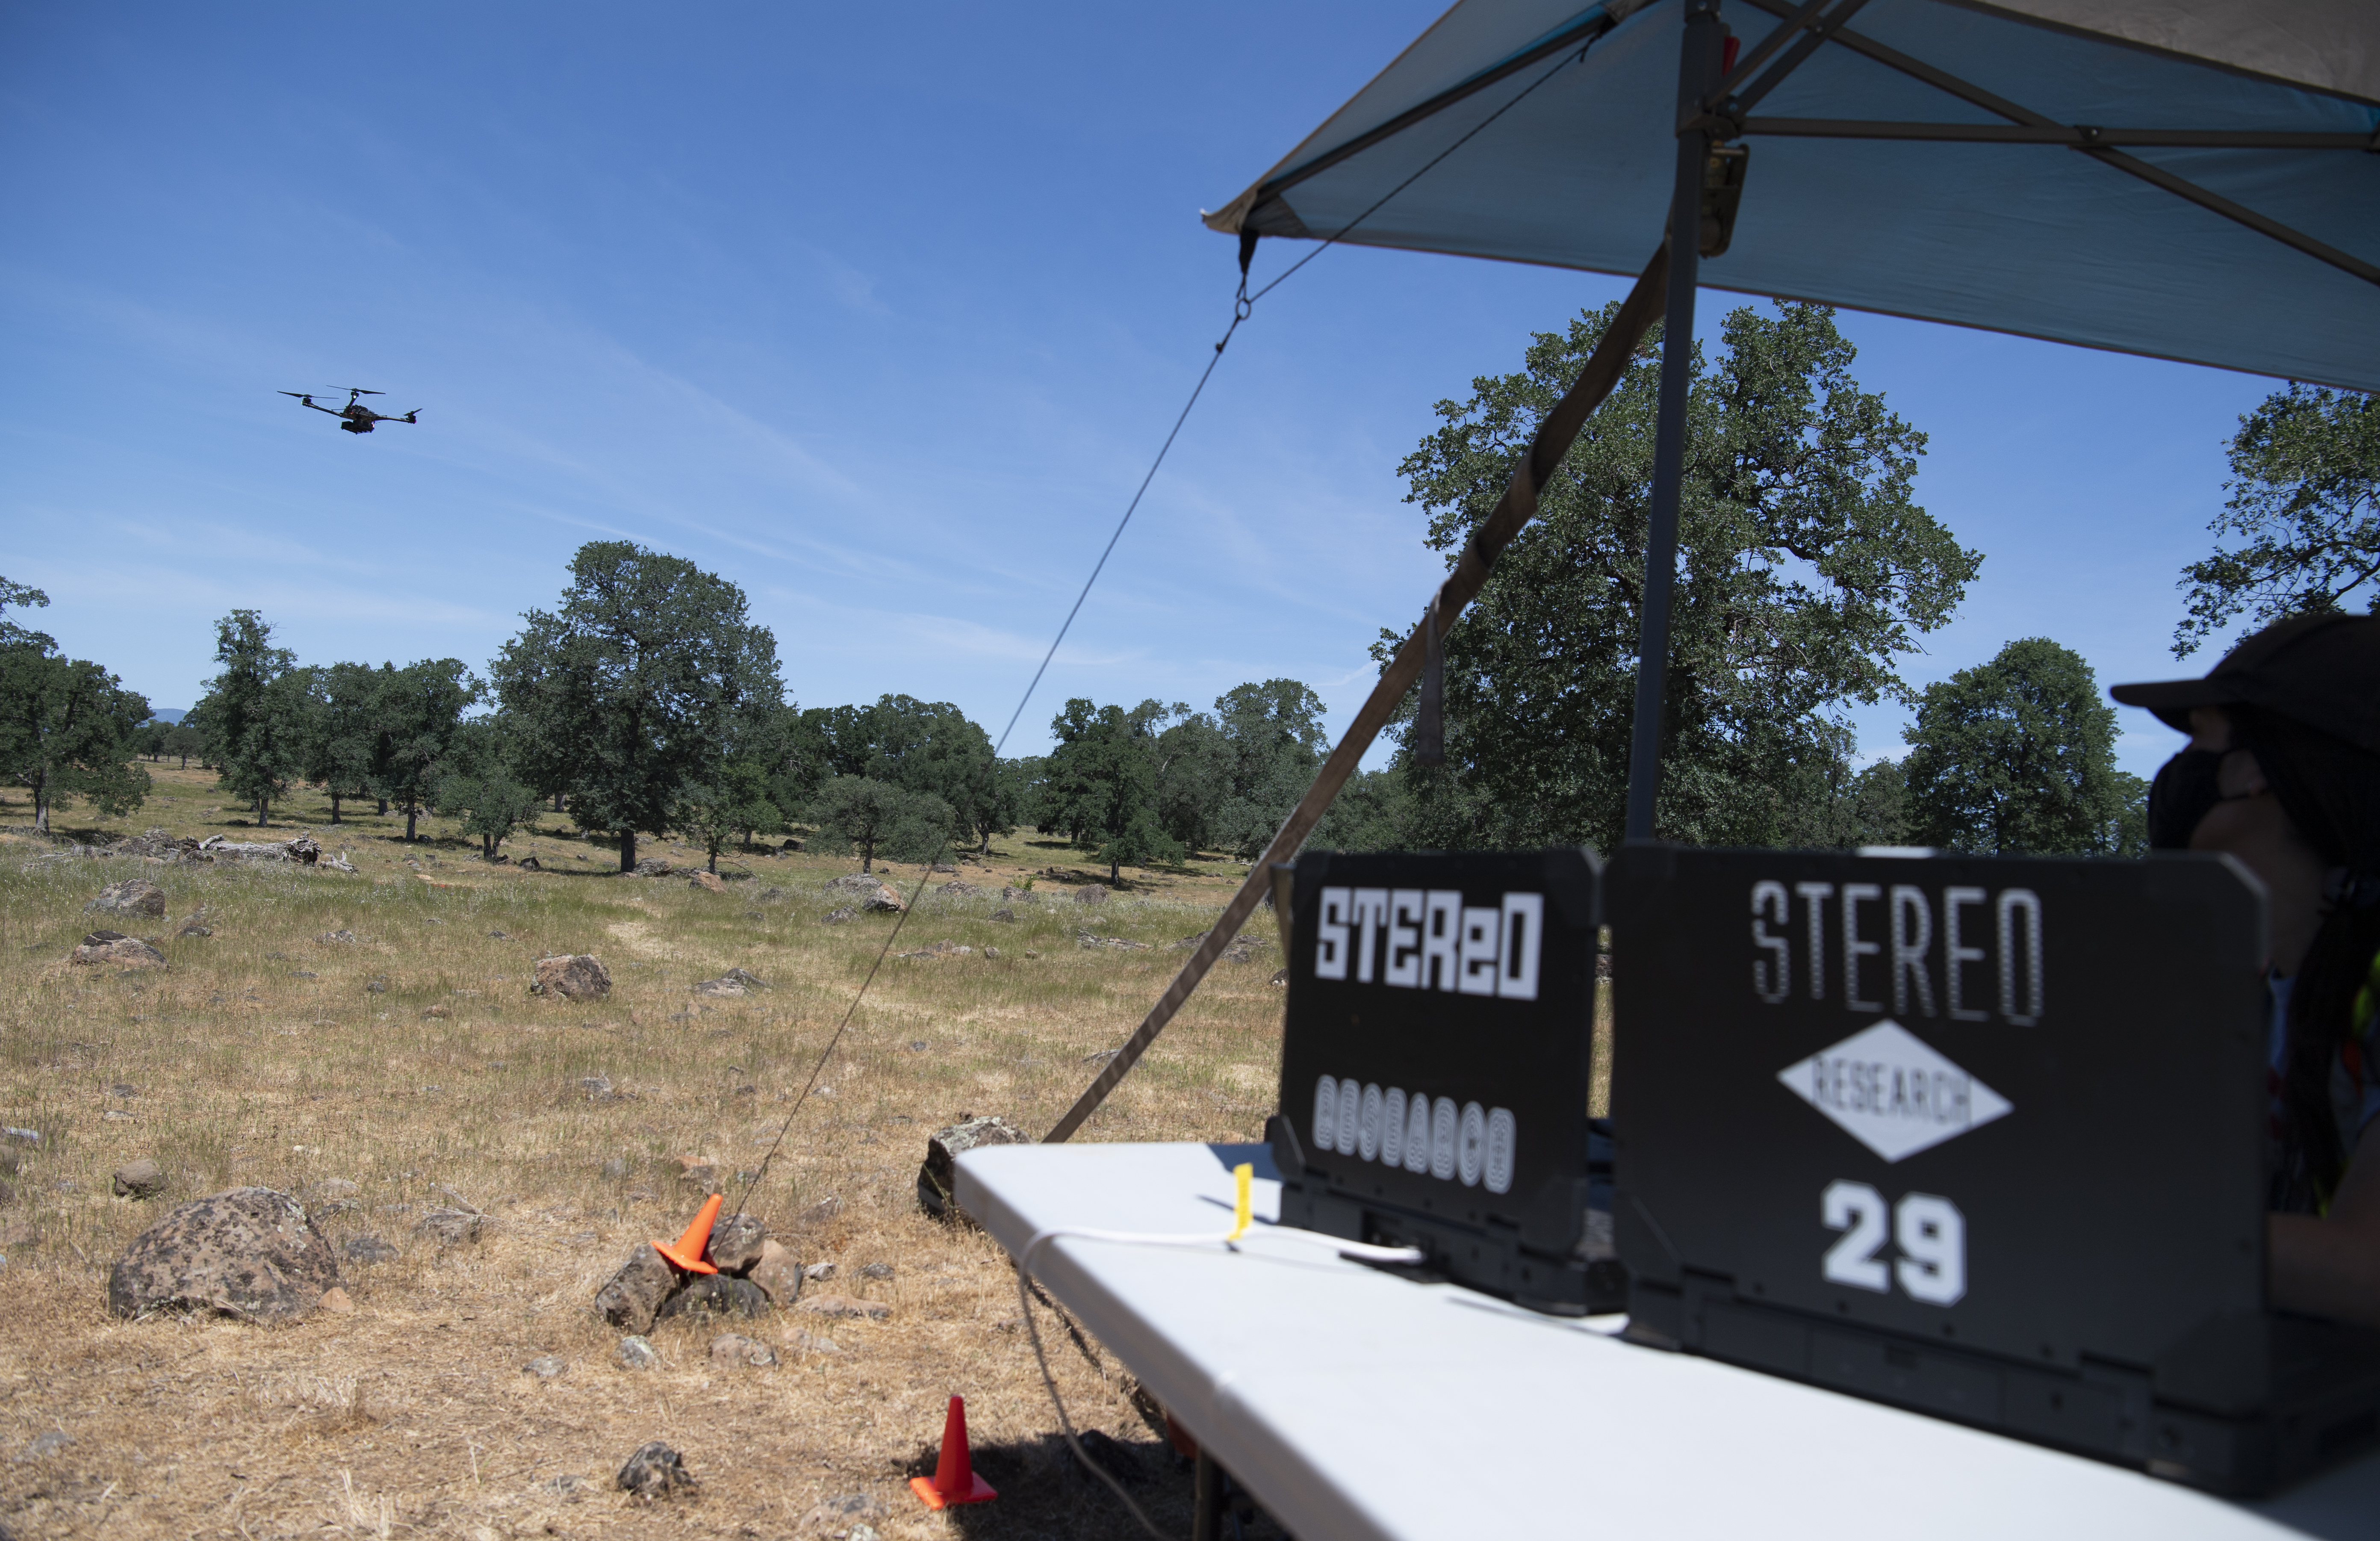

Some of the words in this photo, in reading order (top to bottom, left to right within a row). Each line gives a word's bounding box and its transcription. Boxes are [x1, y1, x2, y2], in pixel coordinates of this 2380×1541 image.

[1315, 887, 1543, 1000] STEReO
[1752, 881, 2041, 1026] STEREO
[1812, 1054, 1972, 1125] RESEARCH
[1821, 1179, 1967, 1307] 29
